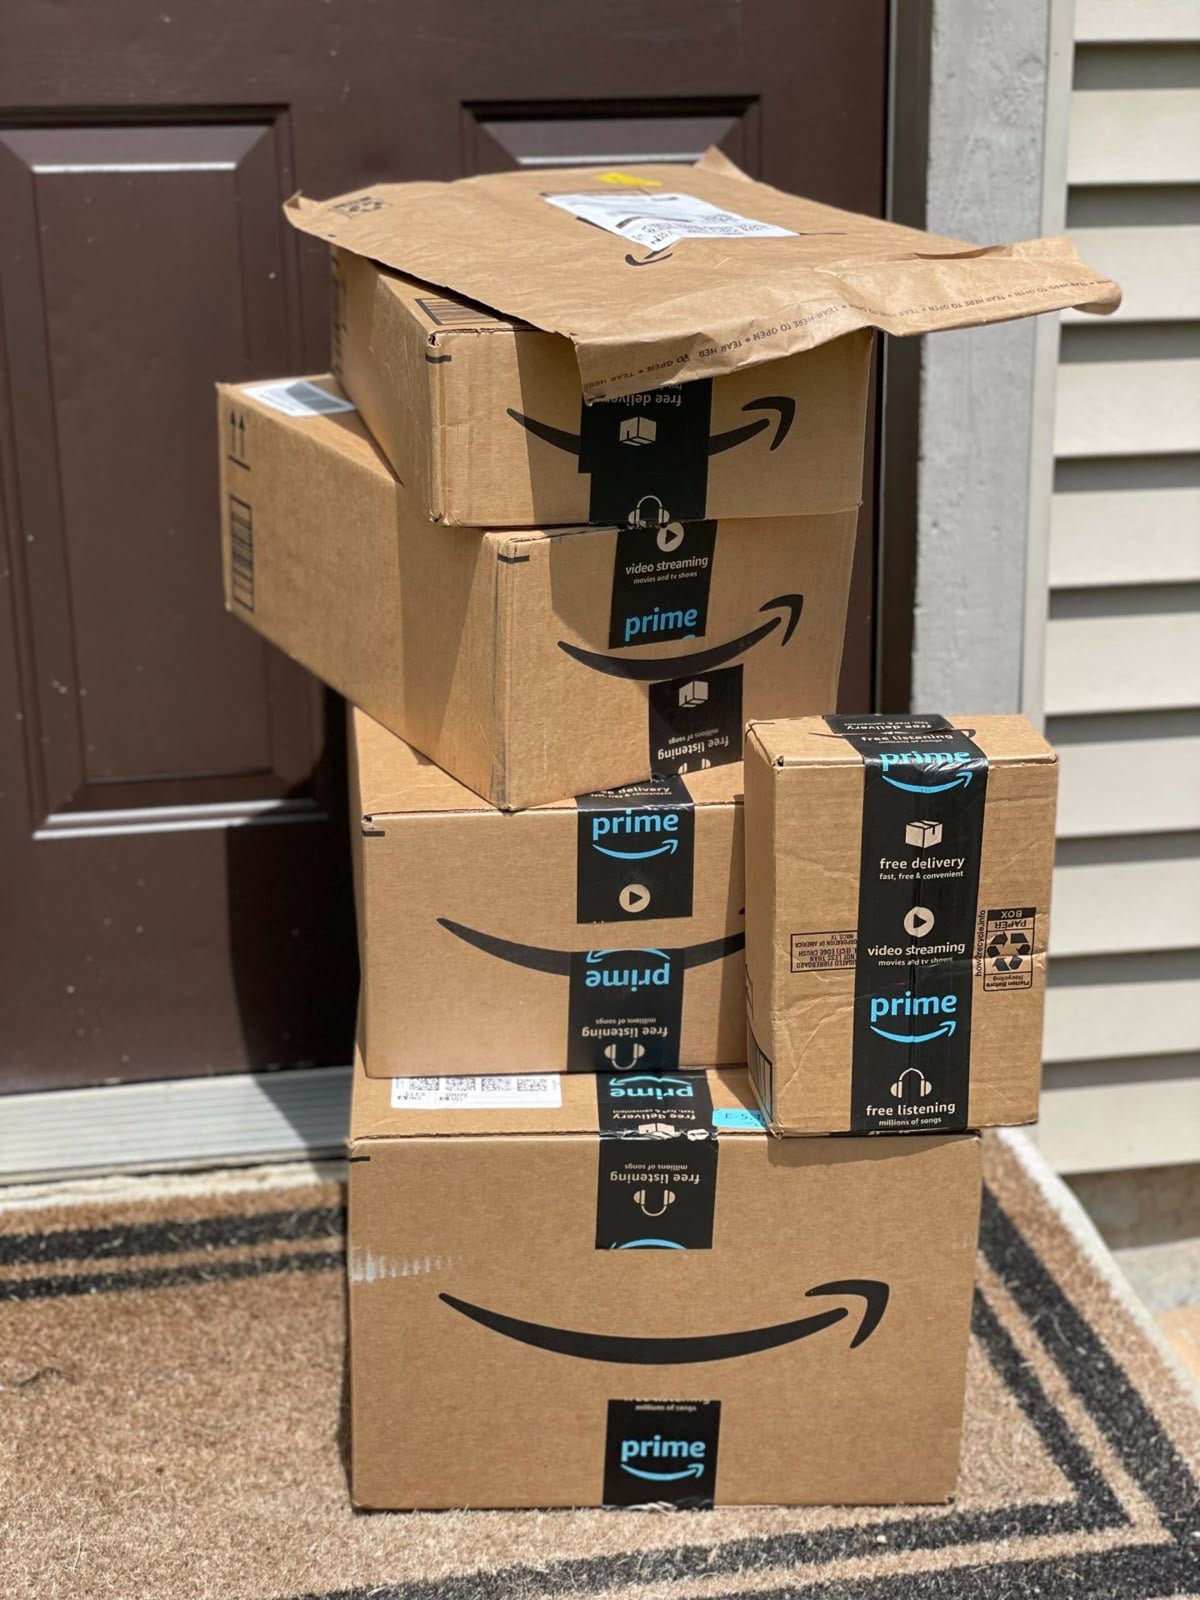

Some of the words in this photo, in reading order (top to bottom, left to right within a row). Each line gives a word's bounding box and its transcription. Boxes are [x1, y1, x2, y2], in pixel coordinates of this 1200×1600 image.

[928, 304, 949, 312] OPEN
[794, 315, 815, 328] HERE
[780, 324, 792, 332] TO
[753, 328, 778, 341] OPEN
[720, 339, 743, 353] TEAR
[698, 347, 718, 358] HER
[647, 360, 674, 372] OPEN
[611, 372, 634, 381] TEAR
[656, 394, 682, 407] free
[625, 563, 655, 575] video
[656, 556, 709, 572] streaming
[633, 577, 656, 585] movies
[657, 573, 669, 581] and
[678, 571, 698, 579] shows
[624, 607, 698, 642] prime
[687, 733, 694, 742] of
[694, 728, 719, 737] millions
[892, 734, 954, 742] listening
[668, 736, 686, 745] songs
[708, 736, 729, 748] free
[657, 742, 705, 760] listening
[880, 750, 972, 771] prime
[618, 786, 671, 794] delivery
[592, 808, 679, 841] prime
[880, 858, 908, 869] free
[911, 857, 965, 870] delivery
[879, 873, 897, 881] fast,
[899, 872, 915, 880] free
[923, 870, 964, 880] convenient
[1001, 910, 1023, 919] BOX
[994, 919, 1027, 929] PAPER
[867, 945, 902, 956] video
[905, 942, 966, 956] streaming
[974, 909, 986, 977] how2recycle.info
[878, 959, 906, 967] movies
[585, 963, 671, 992] prime
[870, 990, 958, 1022] prime
[617, 1018, 626, 1026] of
[581, 1026, 638, 1039] listening
[642, 1026, 668, 1038] free
[609, 1086, 694, 1099] prime
[866, 1105, 894, 1116] free
[898, 1102, 956, 1116] listening
[612, 1112, 667, 1120] delivery
[920, 1117, 942, 1125] songs
[624, 1162, 646, 1170] songs
[647, 1163, 656, 1171] of
[657, 1163, 688, 1171] millions
[609, 1171, 669, 1184] listening
[673, 1173, 700, 1184] free
[666, 1403, 675, 1411] of
[675, 1404, 697, 1412] songs
[621, 1434, 706, 1462] prime
